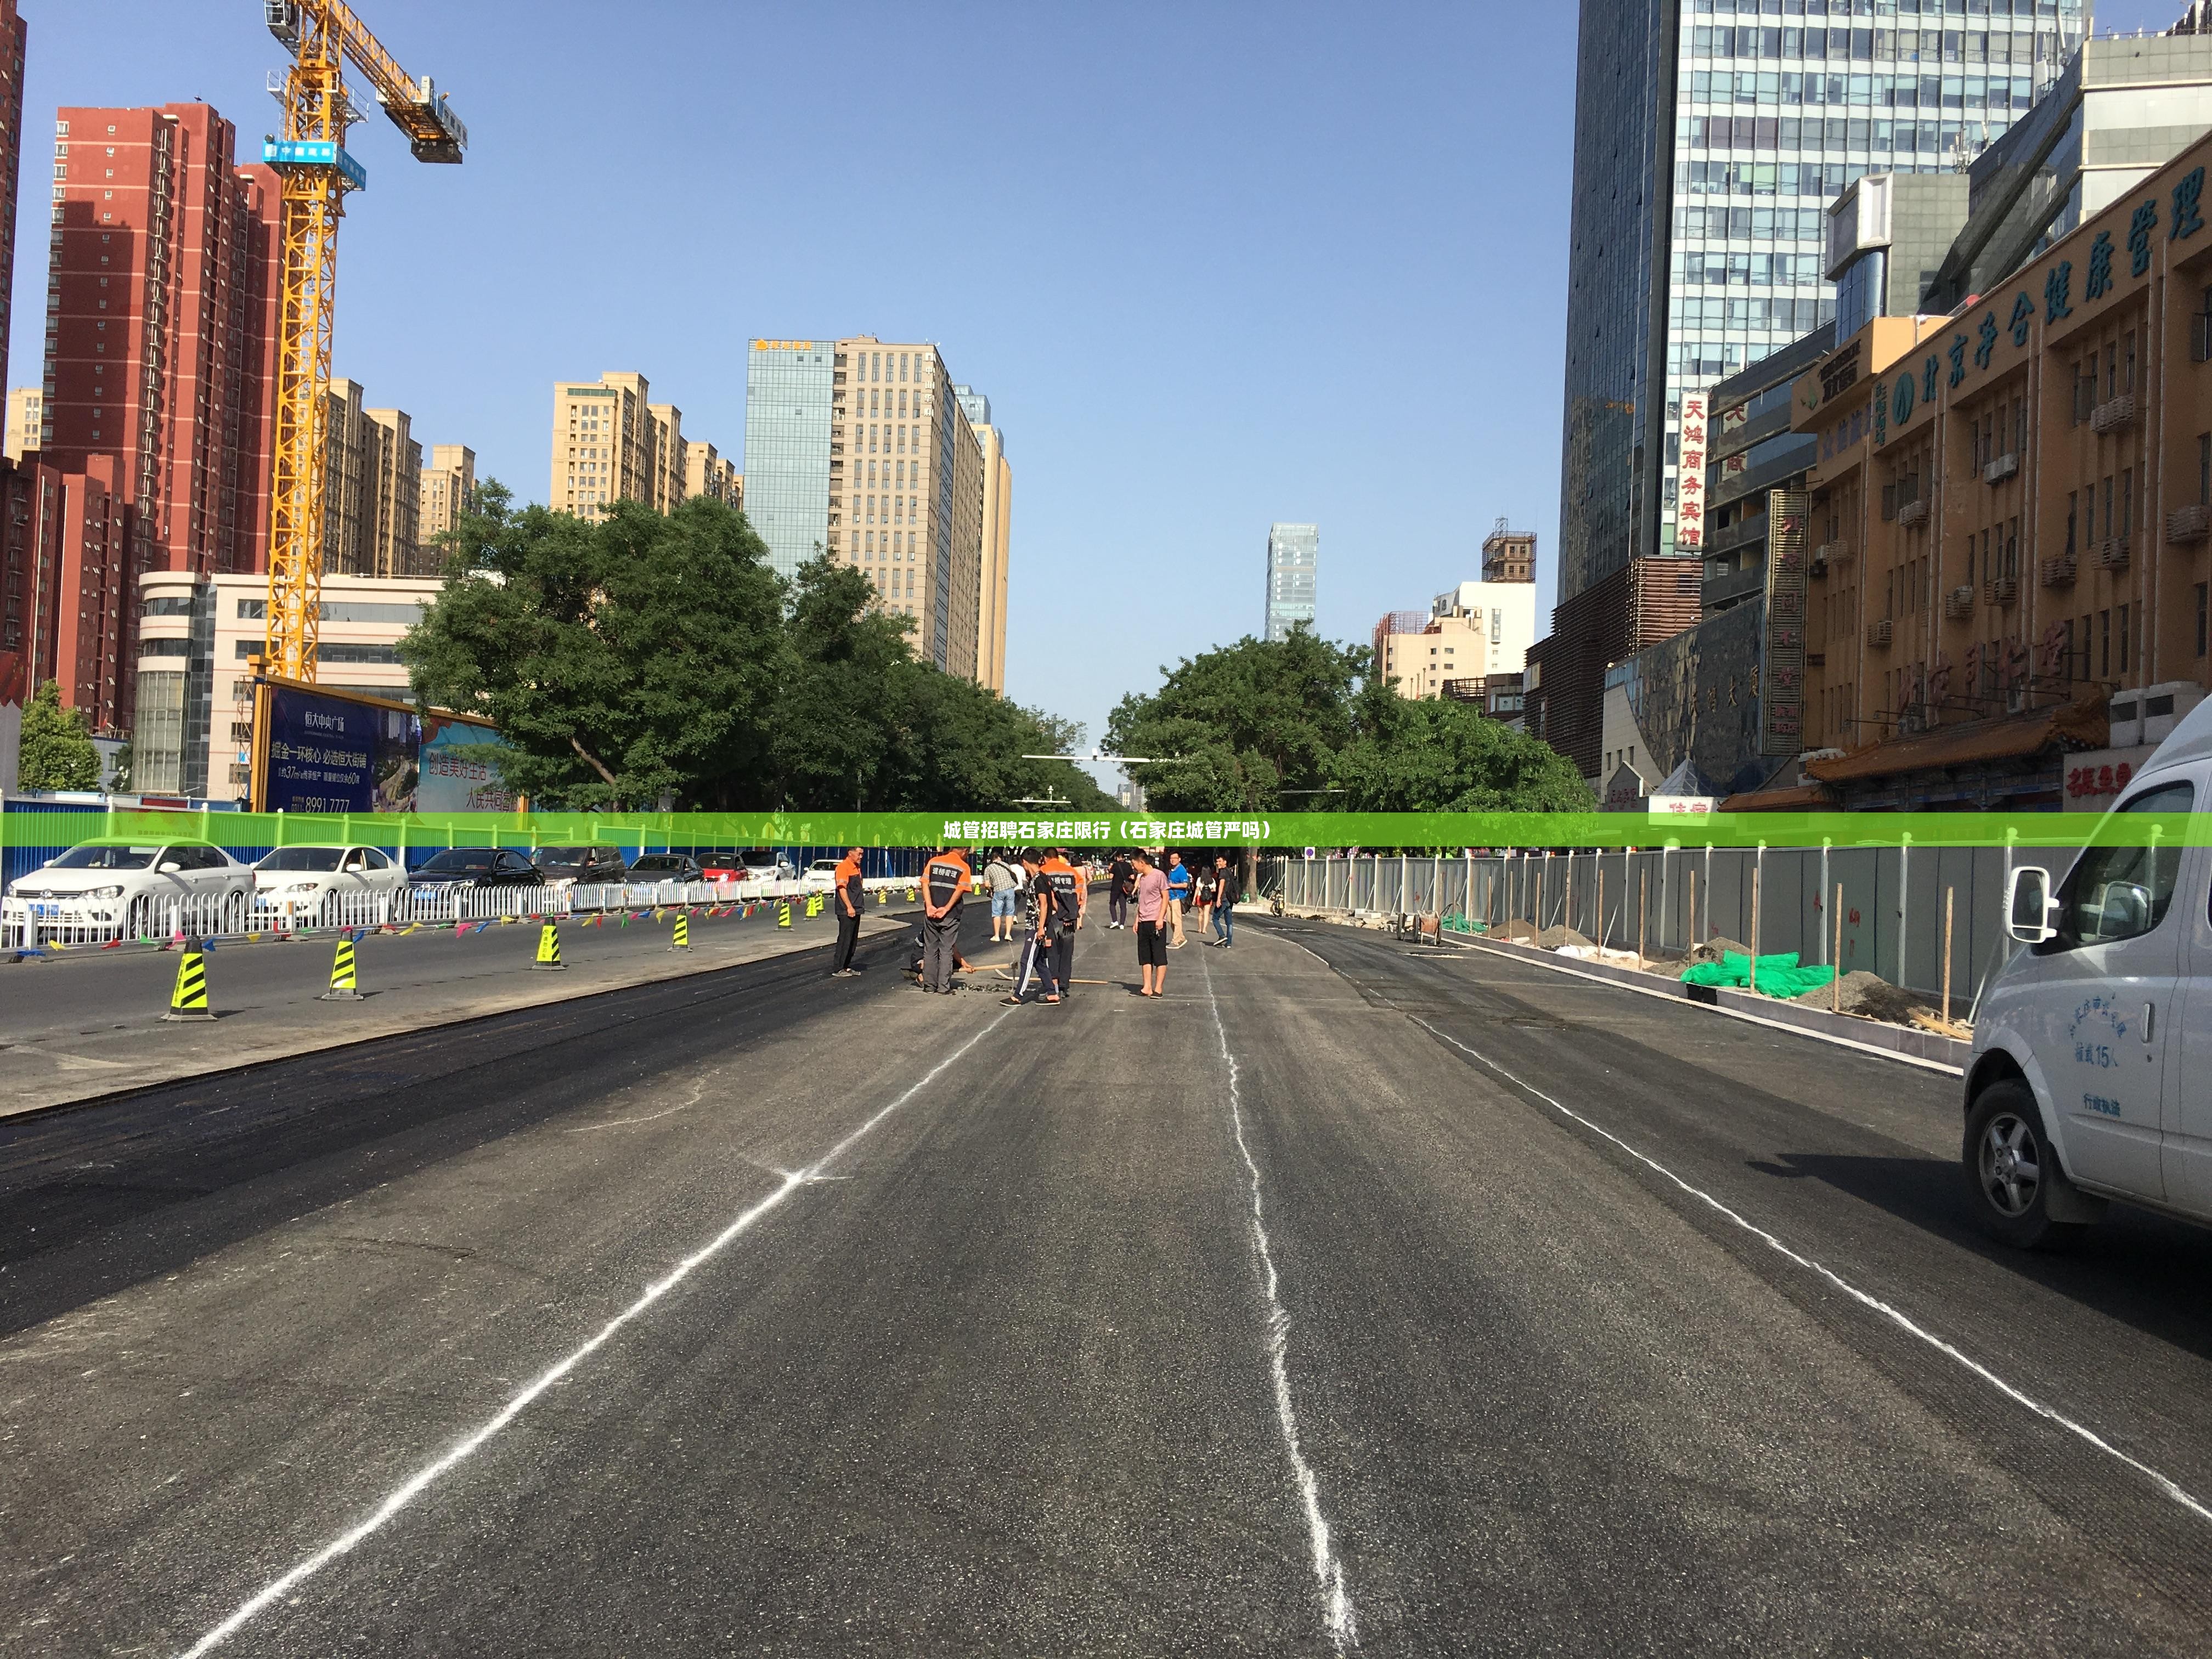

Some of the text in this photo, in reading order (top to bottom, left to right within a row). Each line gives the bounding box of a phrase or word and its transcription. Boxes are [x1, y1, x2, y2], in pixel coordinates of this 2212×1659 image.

[1679, 400, 1705, 546] 天鸿商务宾馆
[305, 711, 345, 732] 恒大中央广场
[271, 741, 322, 765] 掘金一环核心
[428, 752, 487, 781] 创造美好生活
[305, 797, 326, 813] 8991
[330, 798, 350, 814] 7777
